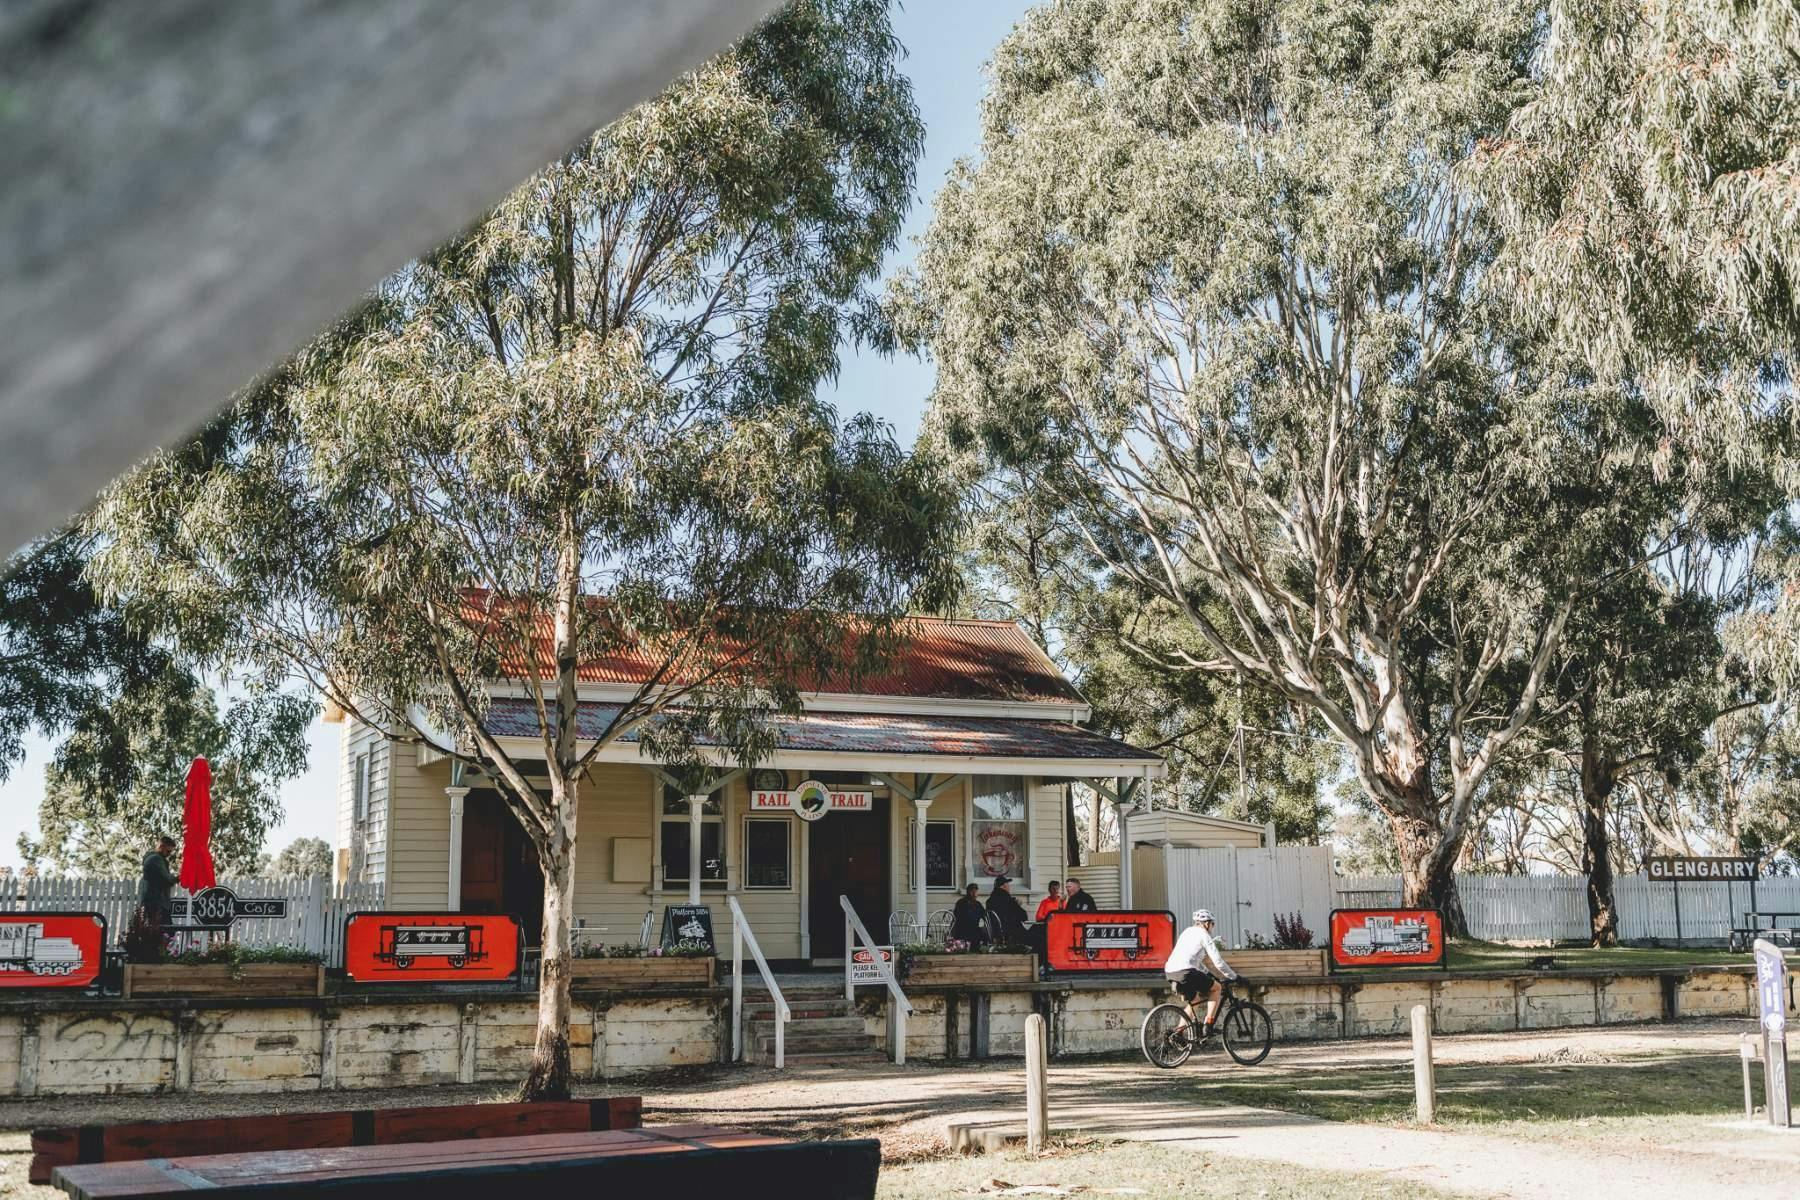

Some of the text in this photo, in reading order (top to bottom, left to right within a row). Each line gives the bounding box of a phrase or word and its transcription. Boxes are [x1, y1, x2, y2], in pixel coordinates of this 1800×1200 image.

[757, 793, 867, 807] RAIL TRAIL
[1650, 861, 1755, 877] GLENGARRY
[198, 894, 235, 918] 3854
[244, 902, 276, 915] Cafe
